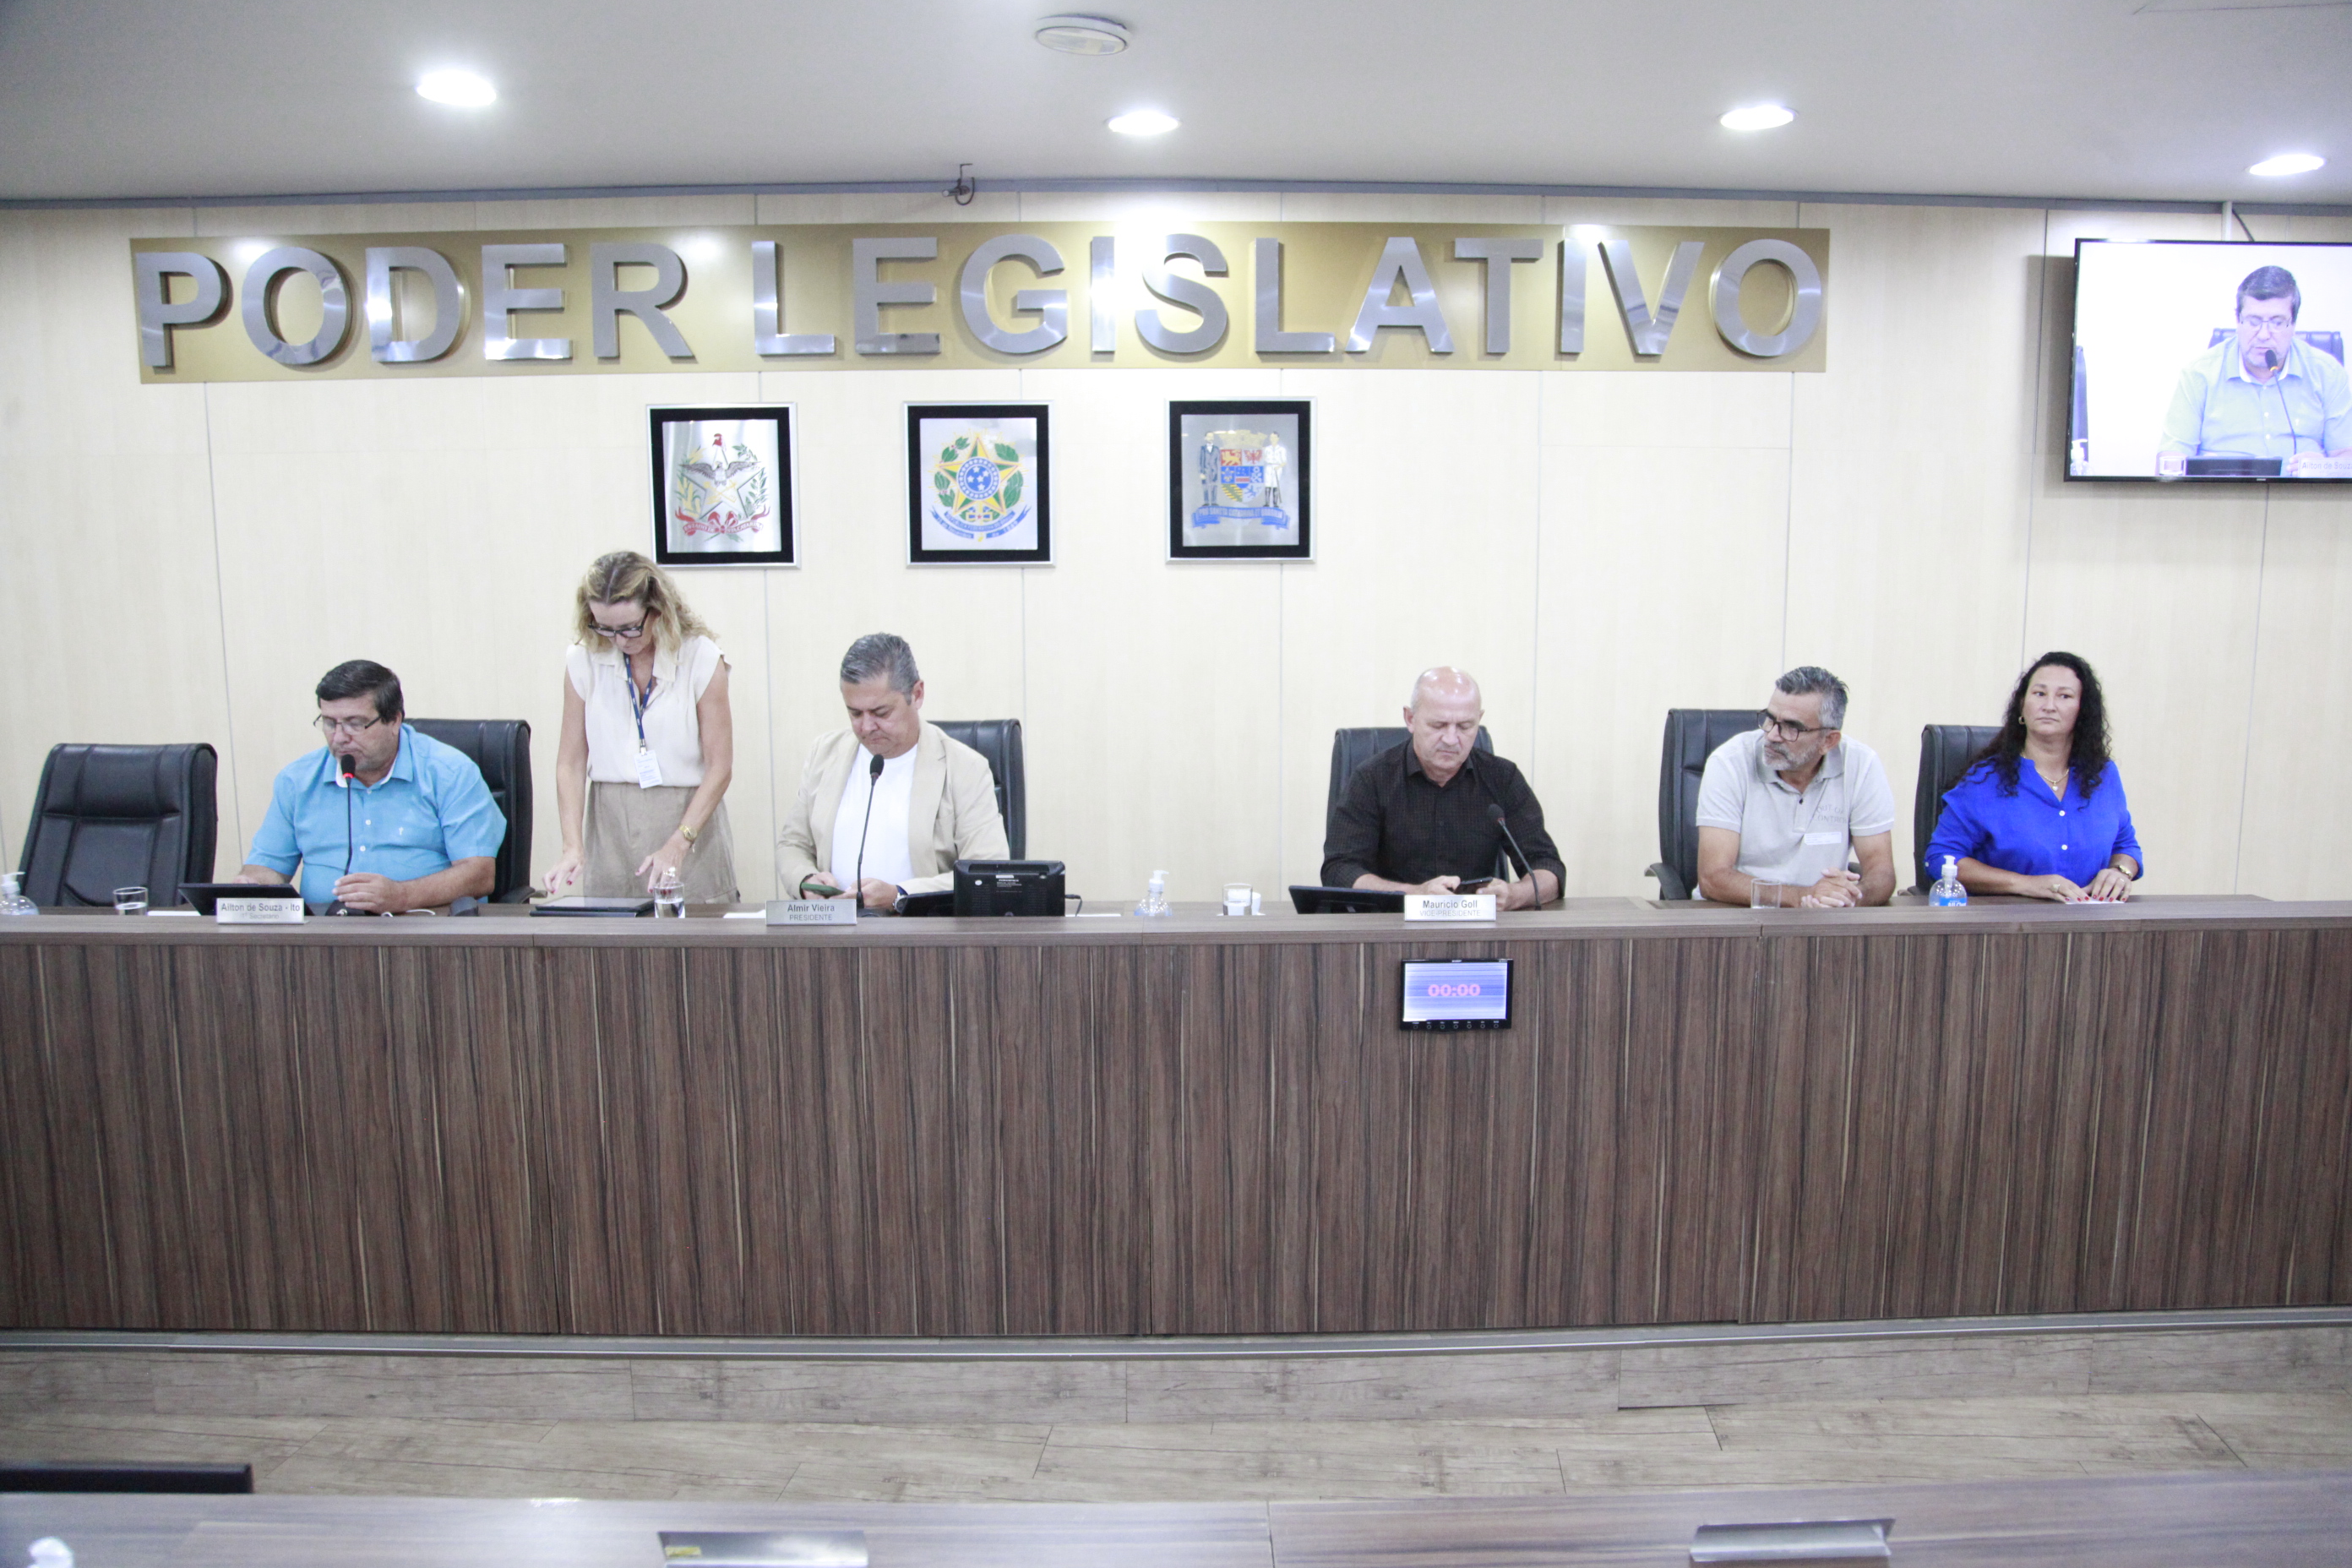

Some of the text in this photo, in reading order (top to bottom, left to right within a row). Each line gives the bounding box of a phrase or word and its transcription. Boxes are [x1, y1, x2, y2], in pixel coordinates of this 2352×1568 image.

[136, 234, 1823, 373] PODER LEGISLATIVO
[2301, 461, 2352, 470] Ailton de Souz
[221, 903, 245, 912] Ailton
[247, 903, 256, 912] de
[259, 903, 283, 912] Souza
[787, 904, 835, 912] Almir Vieira
[1423, 900, 1478, 908] Maurício Goll
[1428, 983, 1481, 997] 00:00
